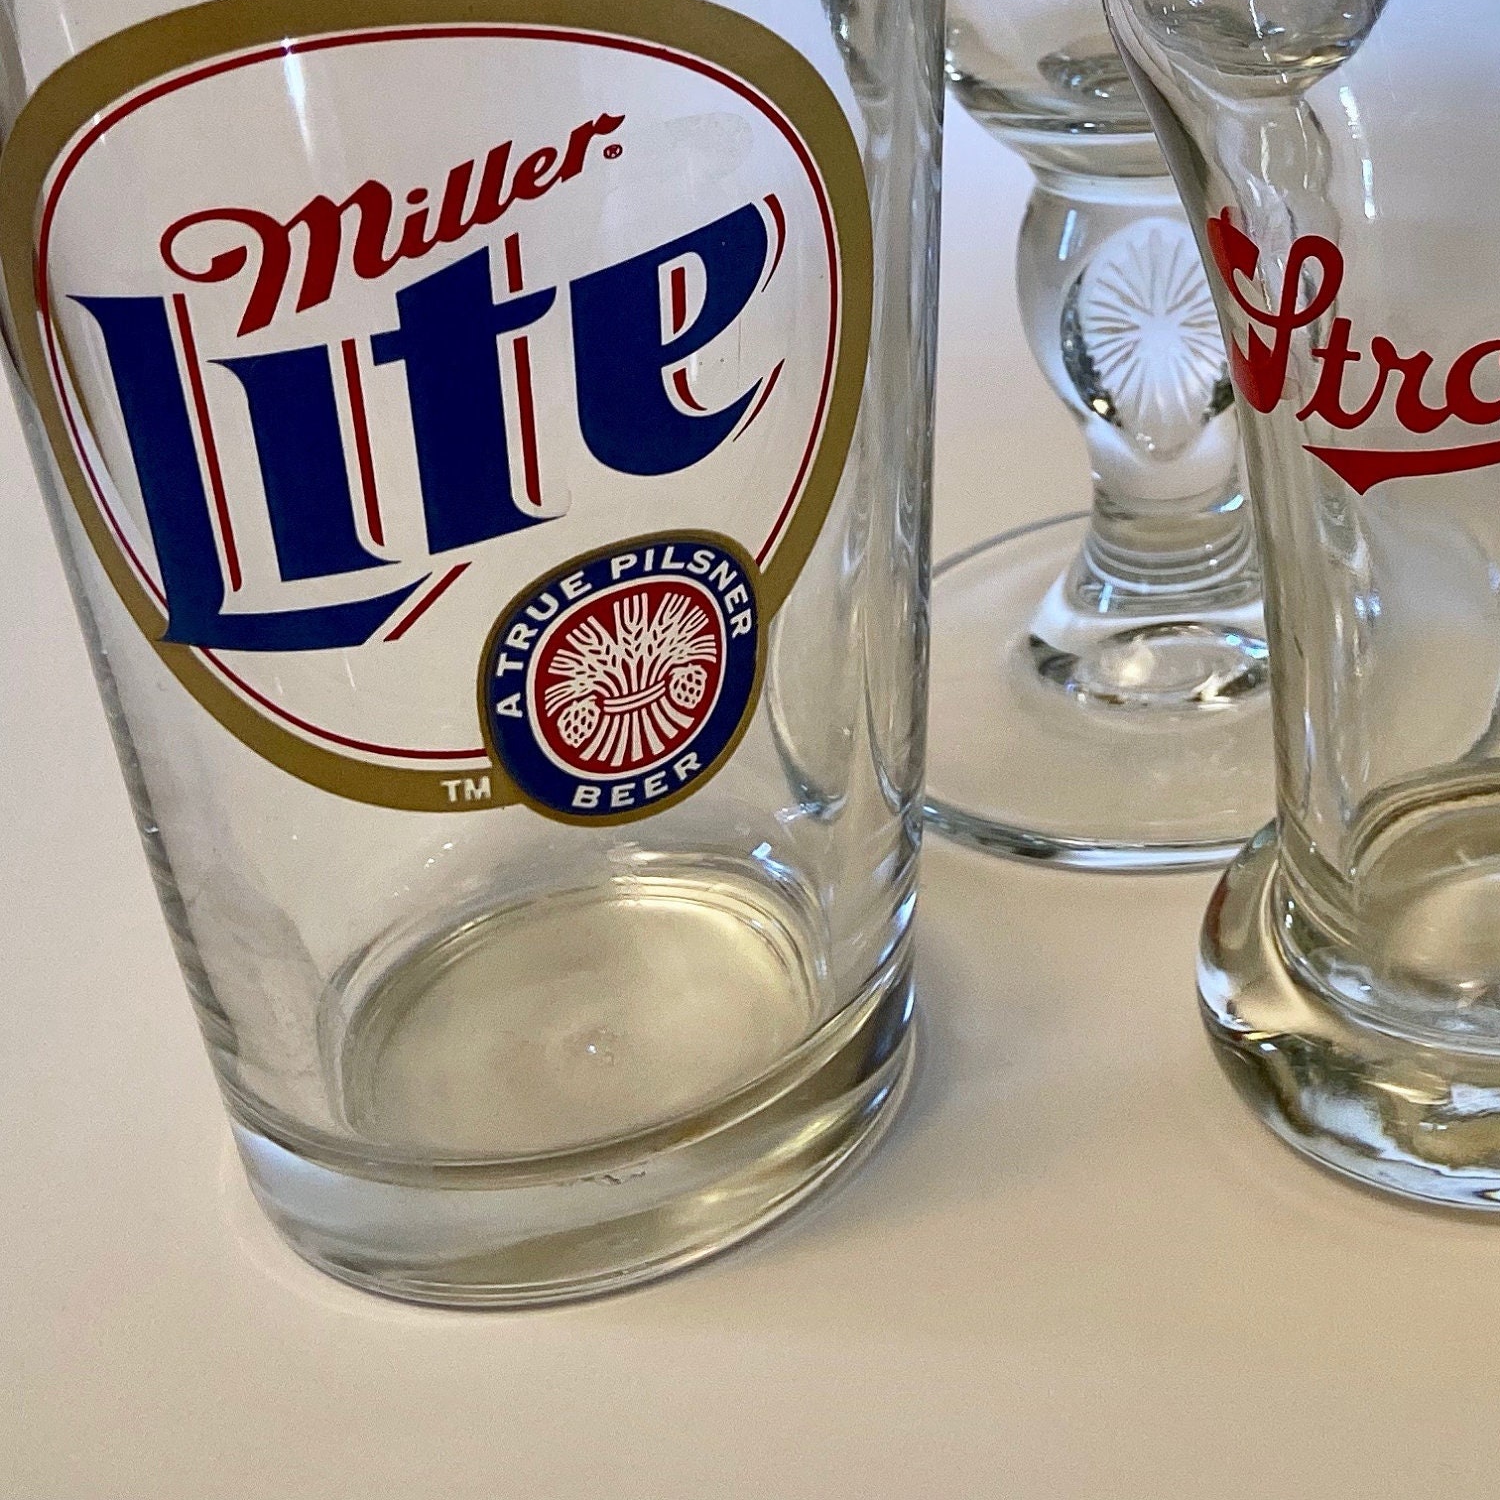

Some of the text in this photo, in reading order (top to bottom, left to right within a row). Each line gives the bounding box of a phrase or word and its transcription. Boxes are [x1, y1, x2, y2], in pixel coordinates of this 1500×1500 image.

[160, 113, 626, 337] Miller
[66, 195, 786, 652] Lite
[496, 546, 752, 718] A TRUE PILSNER
[441, 775, 491, 802] TM
[572, 751, 702, 809] BEER
